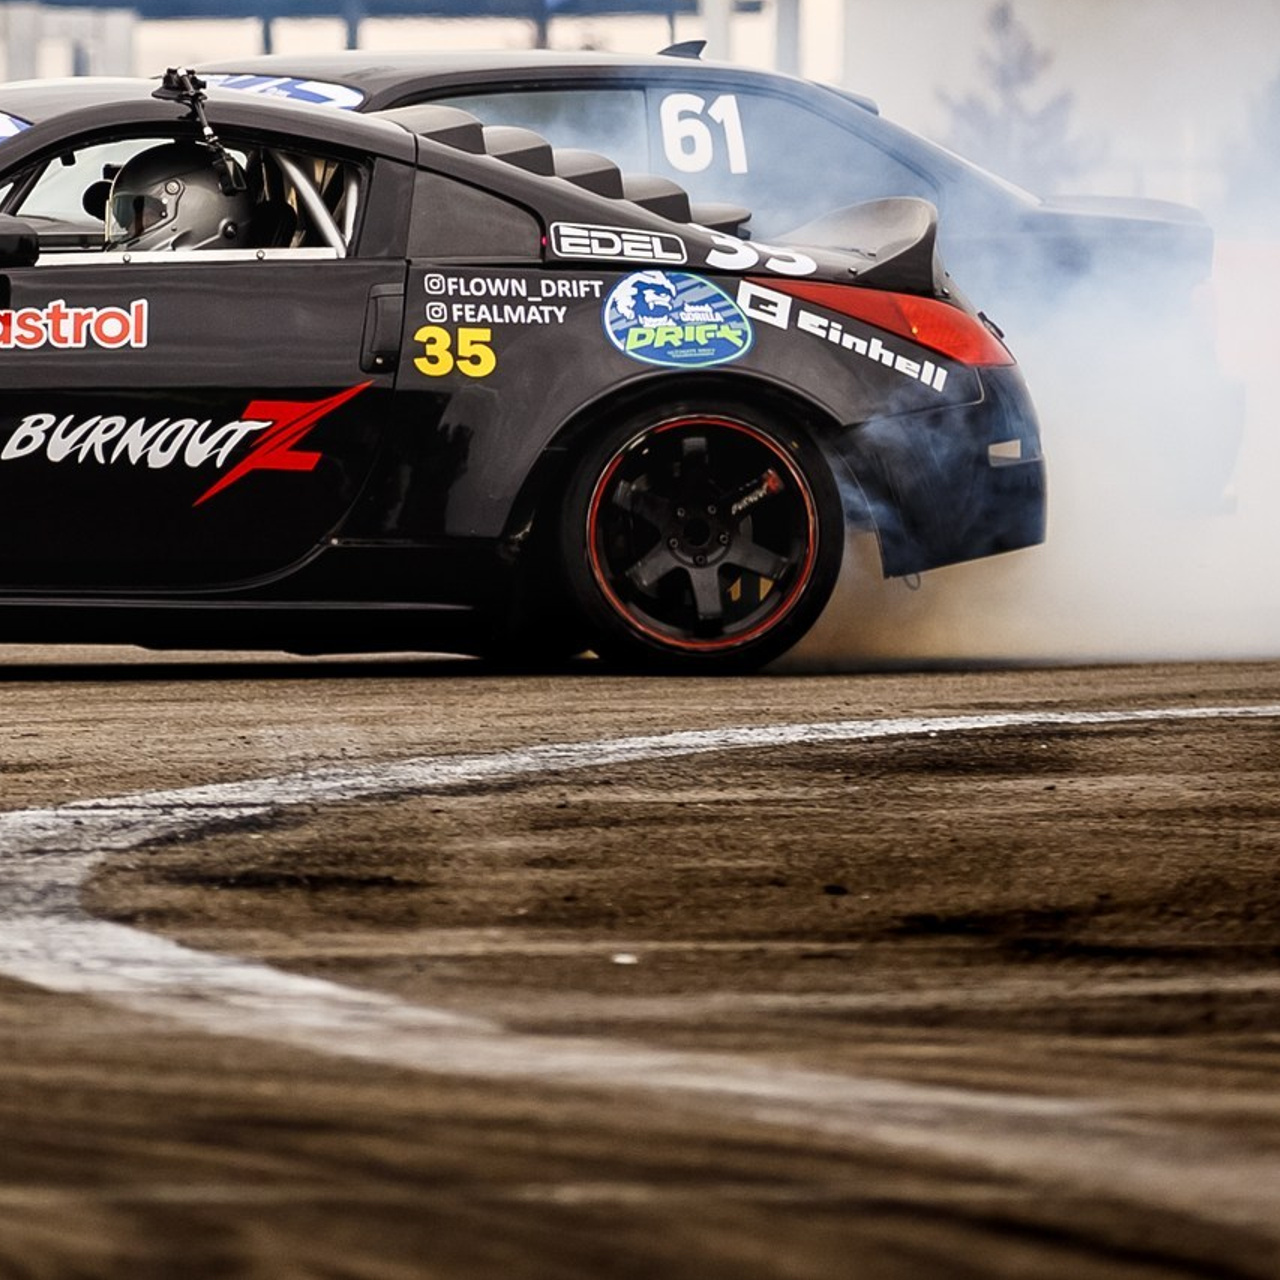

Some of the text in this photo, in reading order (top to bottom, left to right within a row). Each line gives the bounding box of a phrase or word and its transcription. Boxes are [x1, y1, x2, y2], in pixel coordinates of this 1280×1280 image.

[659, 93, 748, 175] 61
[558, 224, 684, 261] EDEL
[448, 277, 603, 302] FLOWN_DRIFT
[452, 304, 567, 324] FEALMATY
[414, 326, 497, 377] 35
[625, 324, 744, 351] DRIFT
